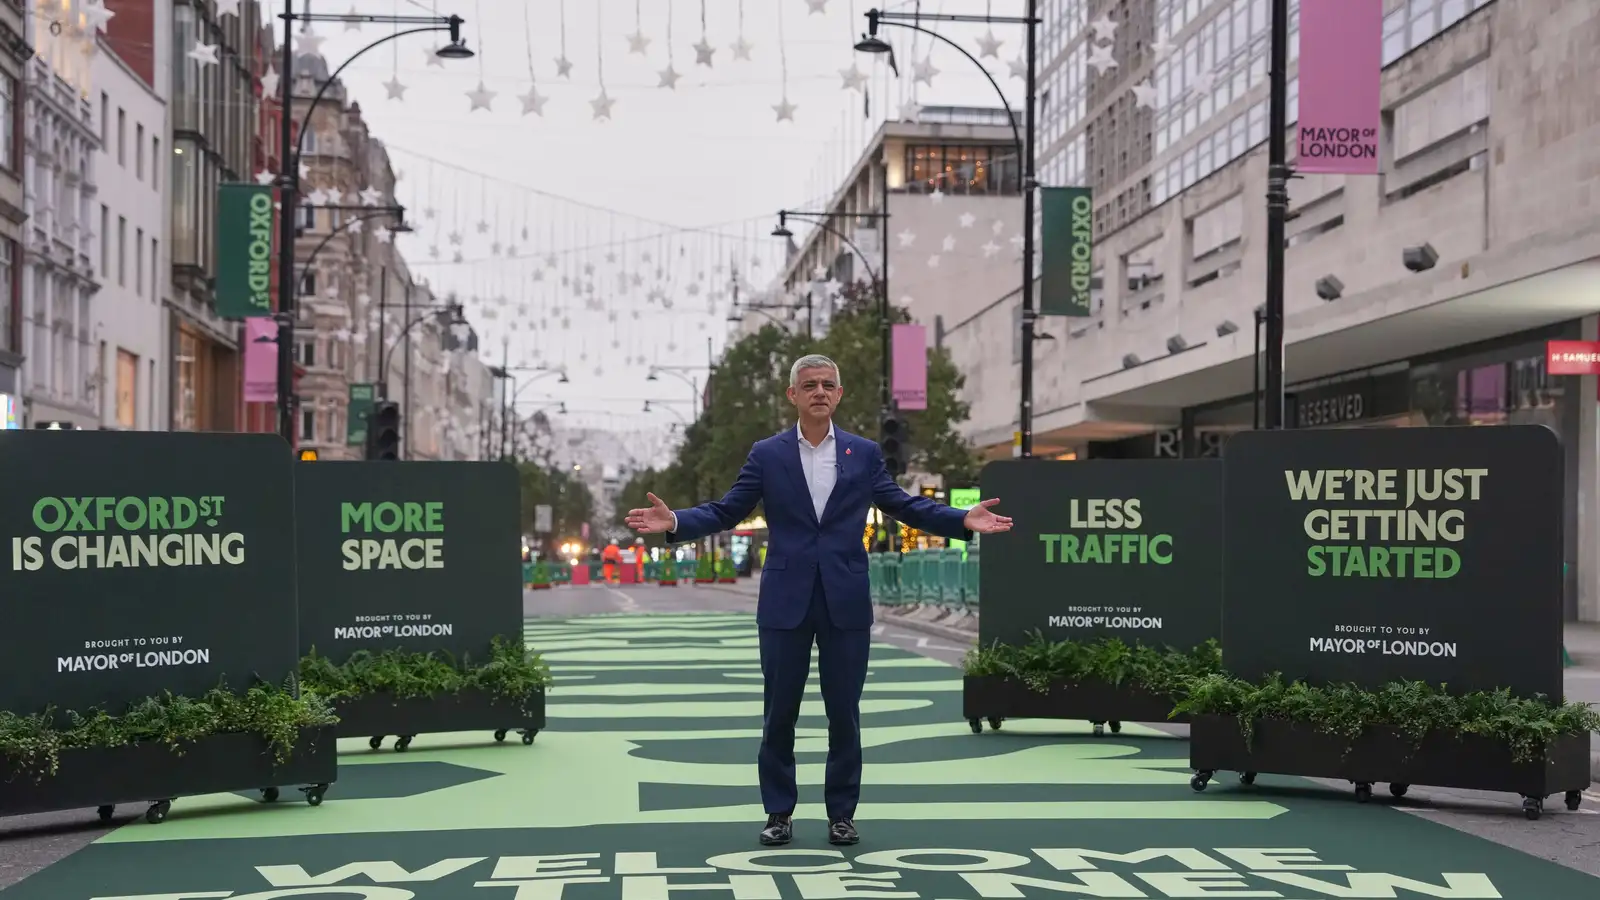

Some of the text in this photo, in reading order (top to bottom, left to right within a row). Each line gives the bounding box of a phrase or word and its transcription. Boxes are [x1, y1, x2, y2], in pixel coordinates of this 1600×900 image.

[1300, 143, 1376, 158] LONDON
[1301, 128, 1376, 142] MAYOR OF
[248, 193, 271, 292] OXFORD
[1071, 196, 1091, 291] OXFORD
[1299, 393, 1364, 426] RESERVED
[1406, 468, 1488, 509] JUST
[32, 496, 198, 533] OXFORD
[341, 501, 444, 533] MORE
[1070, 498, 1143, 529] LESS
[1304, 509, 1465, 542] GETTING
[12, 532, 245, 571] IS CHANGING
[341, 538, 444, 571] SPACE
[1039, 533, 1173, 565] TRAFFIC
[1307, 545, 1461, 579] STARTED
[334, 623, 453, 639] MAYOR OF LONDON
[1048, 615, 1093, 628] MAYOR
[1105, 617, 1162, 629] LONDON
[1334, 625, 1430, 635] BROUGHT TO YOU BY
[84, 636, 183, 649] BROUGHT TO YOU BY
[1309, 637, 1457, 658] MAYOR OF LONDON
[57, 648, 210, 673] MAYOR OF LONDON
[254, 847, 1358, 887] WELCOME
[473, 870, 920, 900] THE
[958, 871, 1503, 899] NEW
